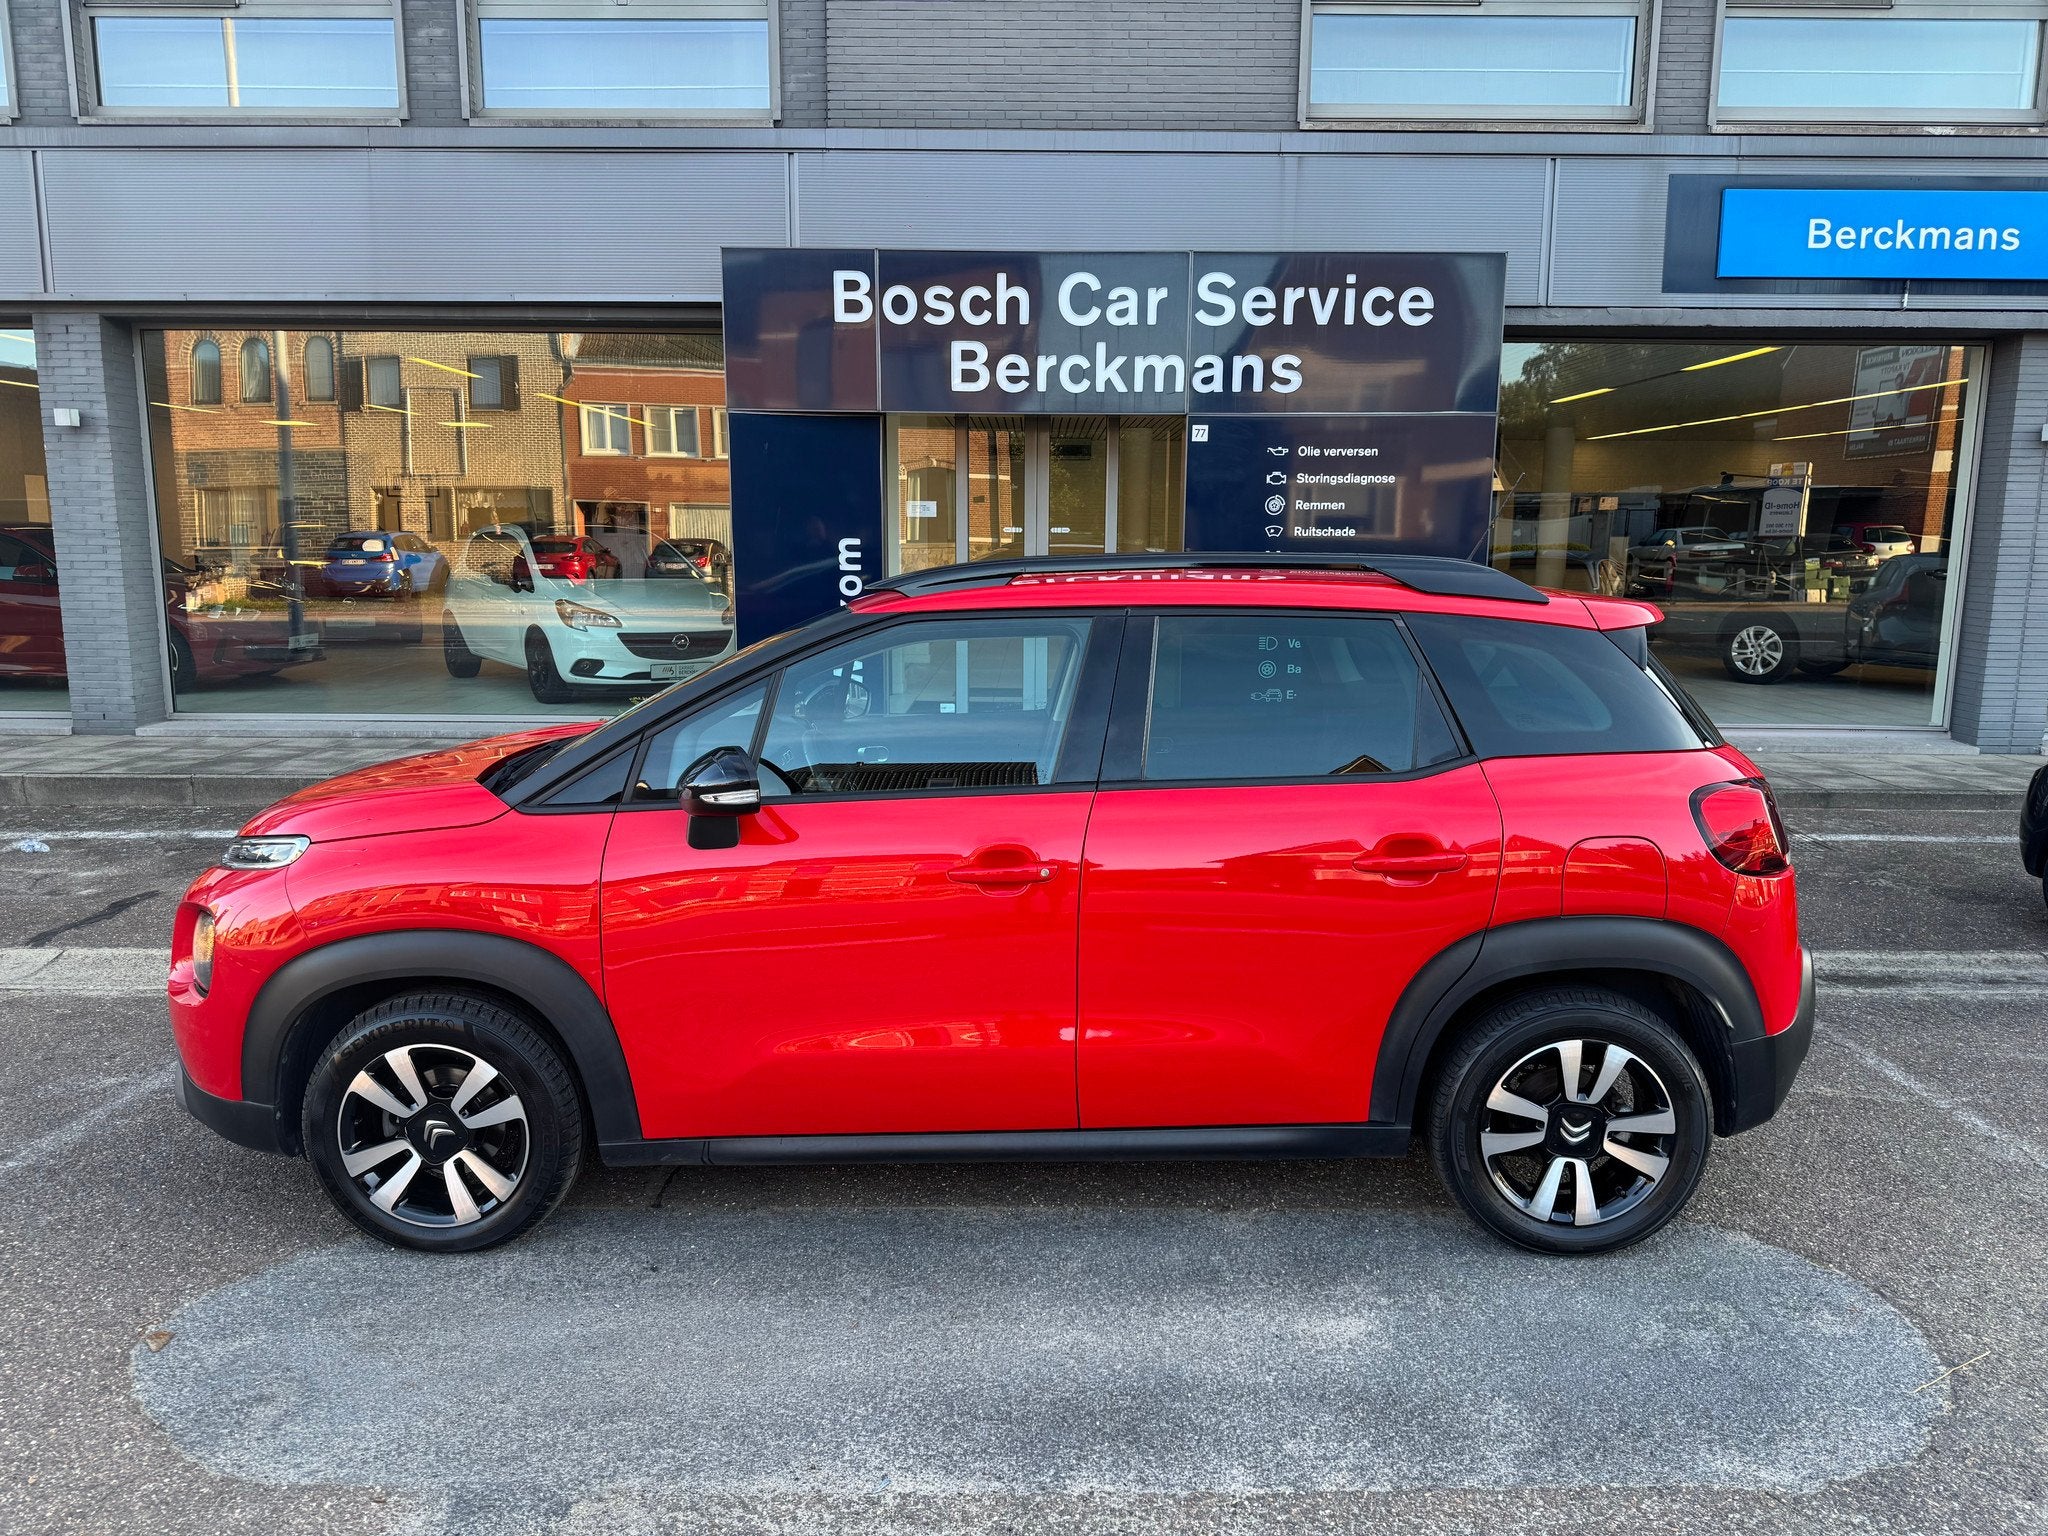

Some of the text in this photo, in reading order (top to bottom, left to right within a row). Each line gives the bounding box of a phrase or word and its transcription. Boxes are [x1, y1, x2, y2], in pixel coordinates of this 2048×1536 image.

[1807, 218, 2020, 251] Berckmans
[832, 270, 1435, 327] Bosch Car Service
[951, 341, 1303, 394] Berckmans
[1194, 428, 1207, 438] 77
[1298, 446, 1379, 457] Olie verversen
[1296, 473, 1396, 486] Storingsdiagnose
[1295, 500, 1346, 511] Remmen
[1294, 526, 1356, 537] Ruitschade
[838, 537, 863, 607] om
